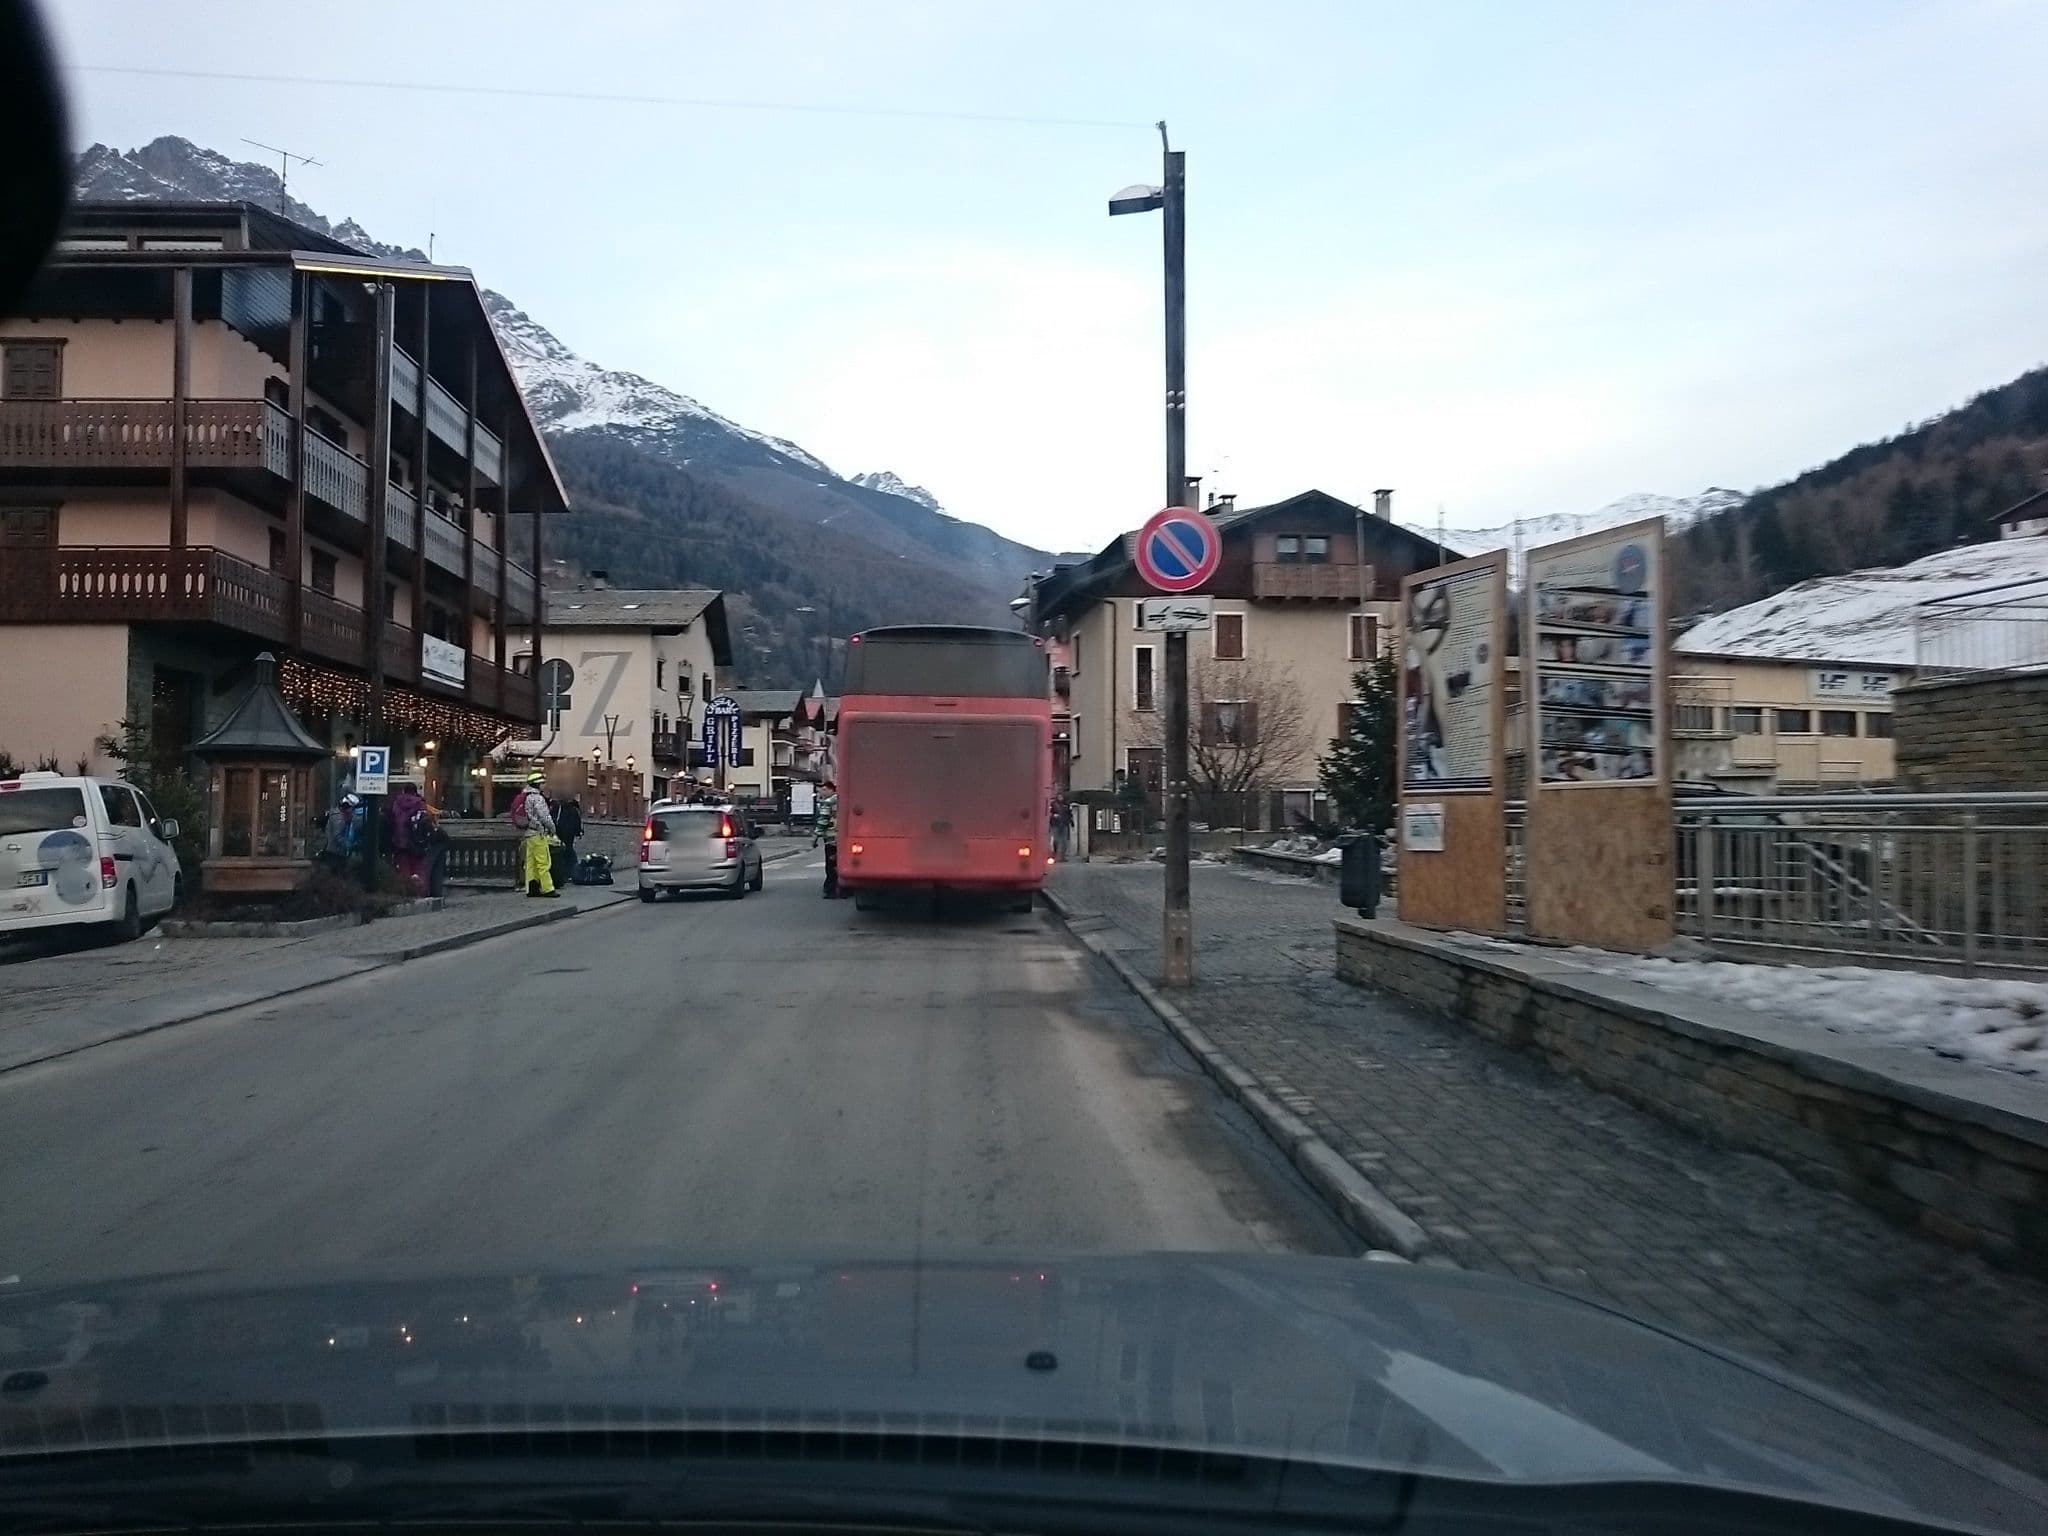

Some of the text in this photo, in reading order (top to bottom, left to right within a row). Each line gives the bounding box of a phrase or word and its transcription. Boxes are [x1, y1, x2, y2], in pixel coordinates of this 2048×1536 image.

[365, 752, 381, 772] P
[706, 717, 716, 763] GRILL
[730, 716, 738, 767] PIZZERIA
